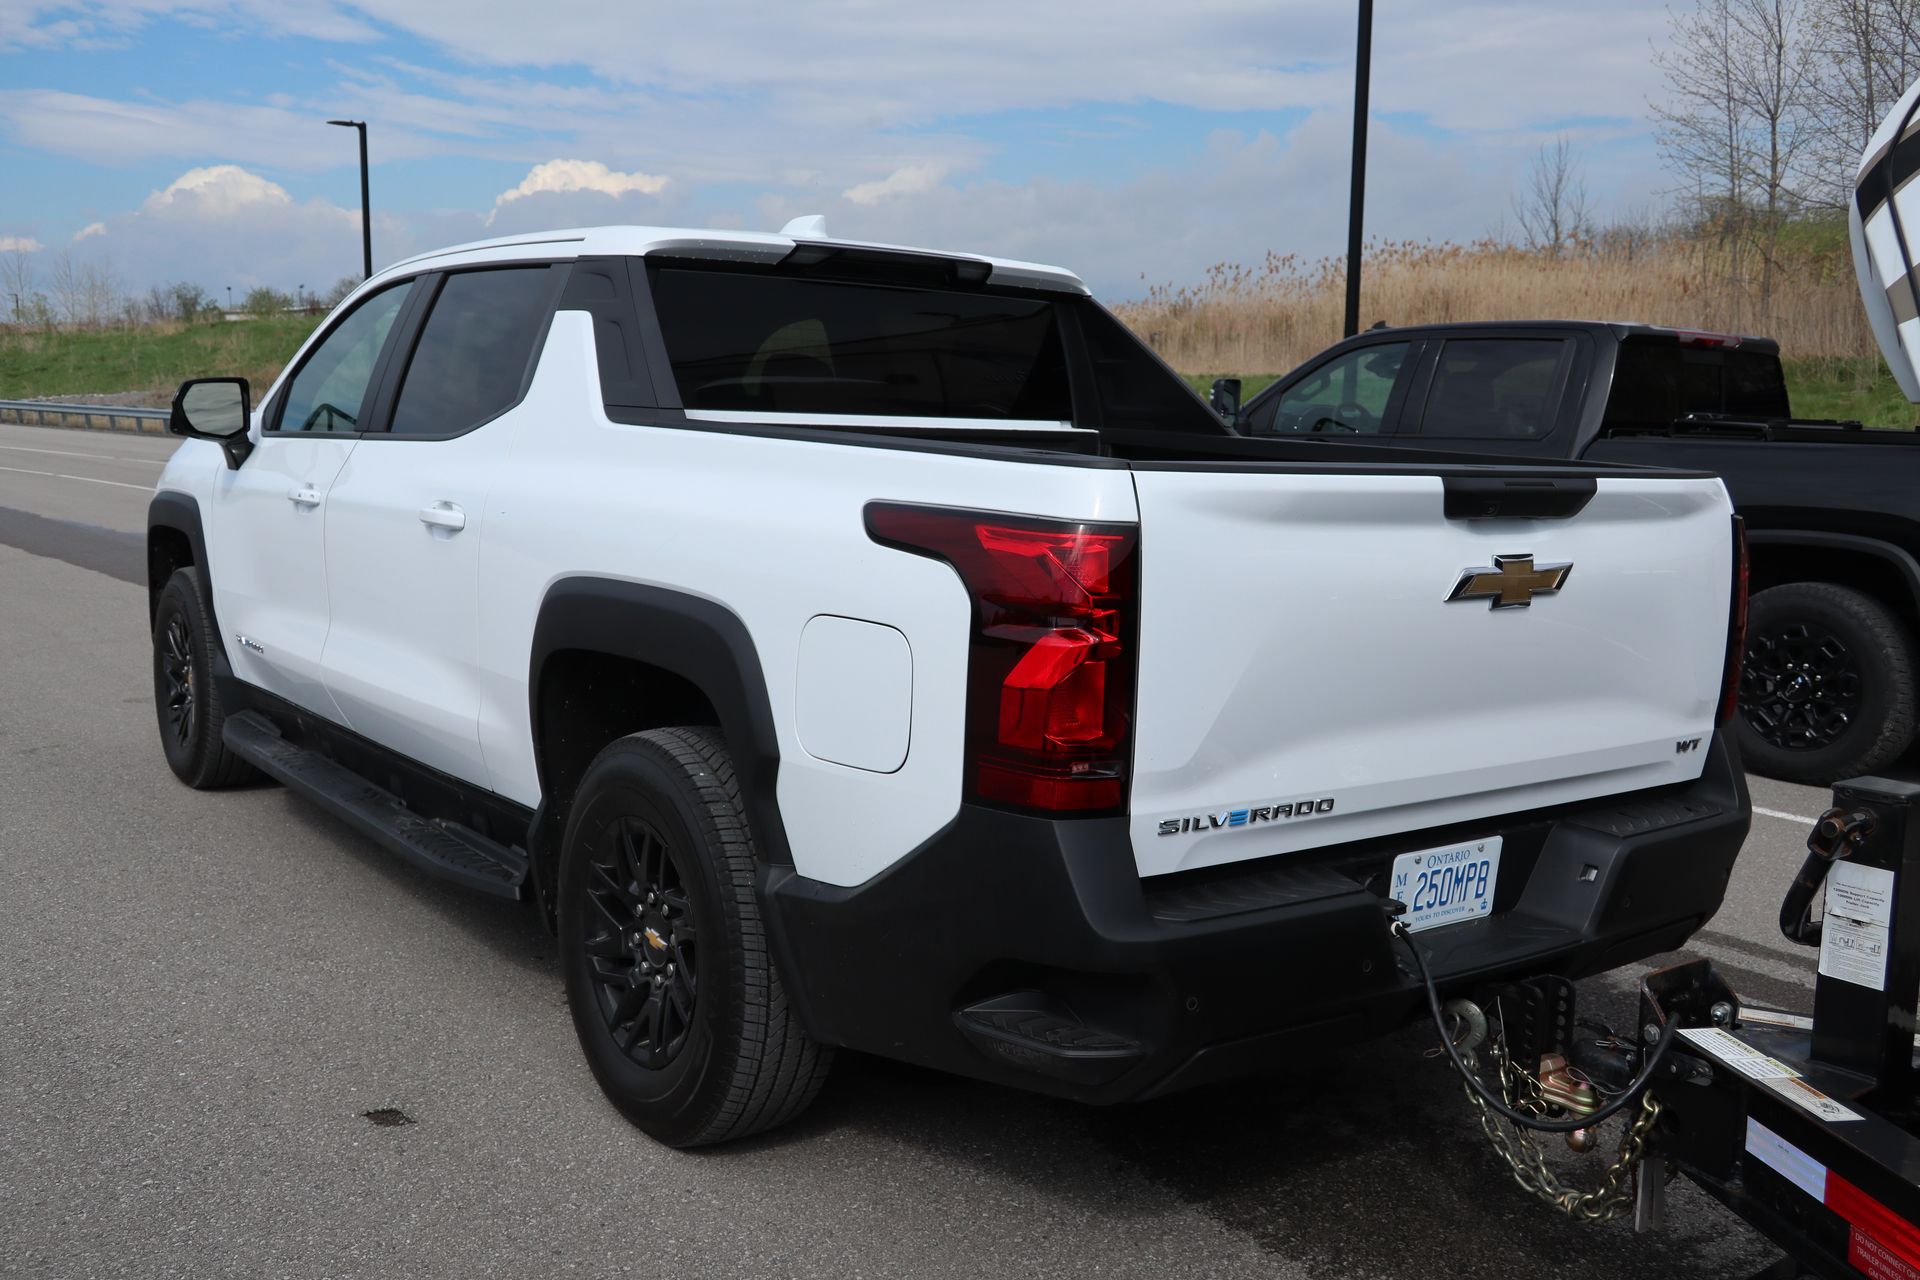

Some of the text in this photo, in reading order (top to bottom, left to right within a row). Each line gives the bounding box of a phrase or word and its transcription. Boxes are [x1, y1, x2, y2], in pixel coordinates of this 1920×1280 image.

[1676, 737, 1702, 754] WT
[1157, 798, 1335, 836] SILVERADO
[1427, 849, 1471, 868] ONTARIO
[1412, 860, 1490, 912] 250MPB
[1415, 914, 1431, 922] YOURS
[1441, 906, 1465, 917] DISCOVER
[1855, 1232, 1864, 1244] DO
[1865, 1239, 1877, 1253] NOT
[1878, 1249, 1906, 1273] CONNECT
[1857, 1246, 1879, 1267] TRAILER
